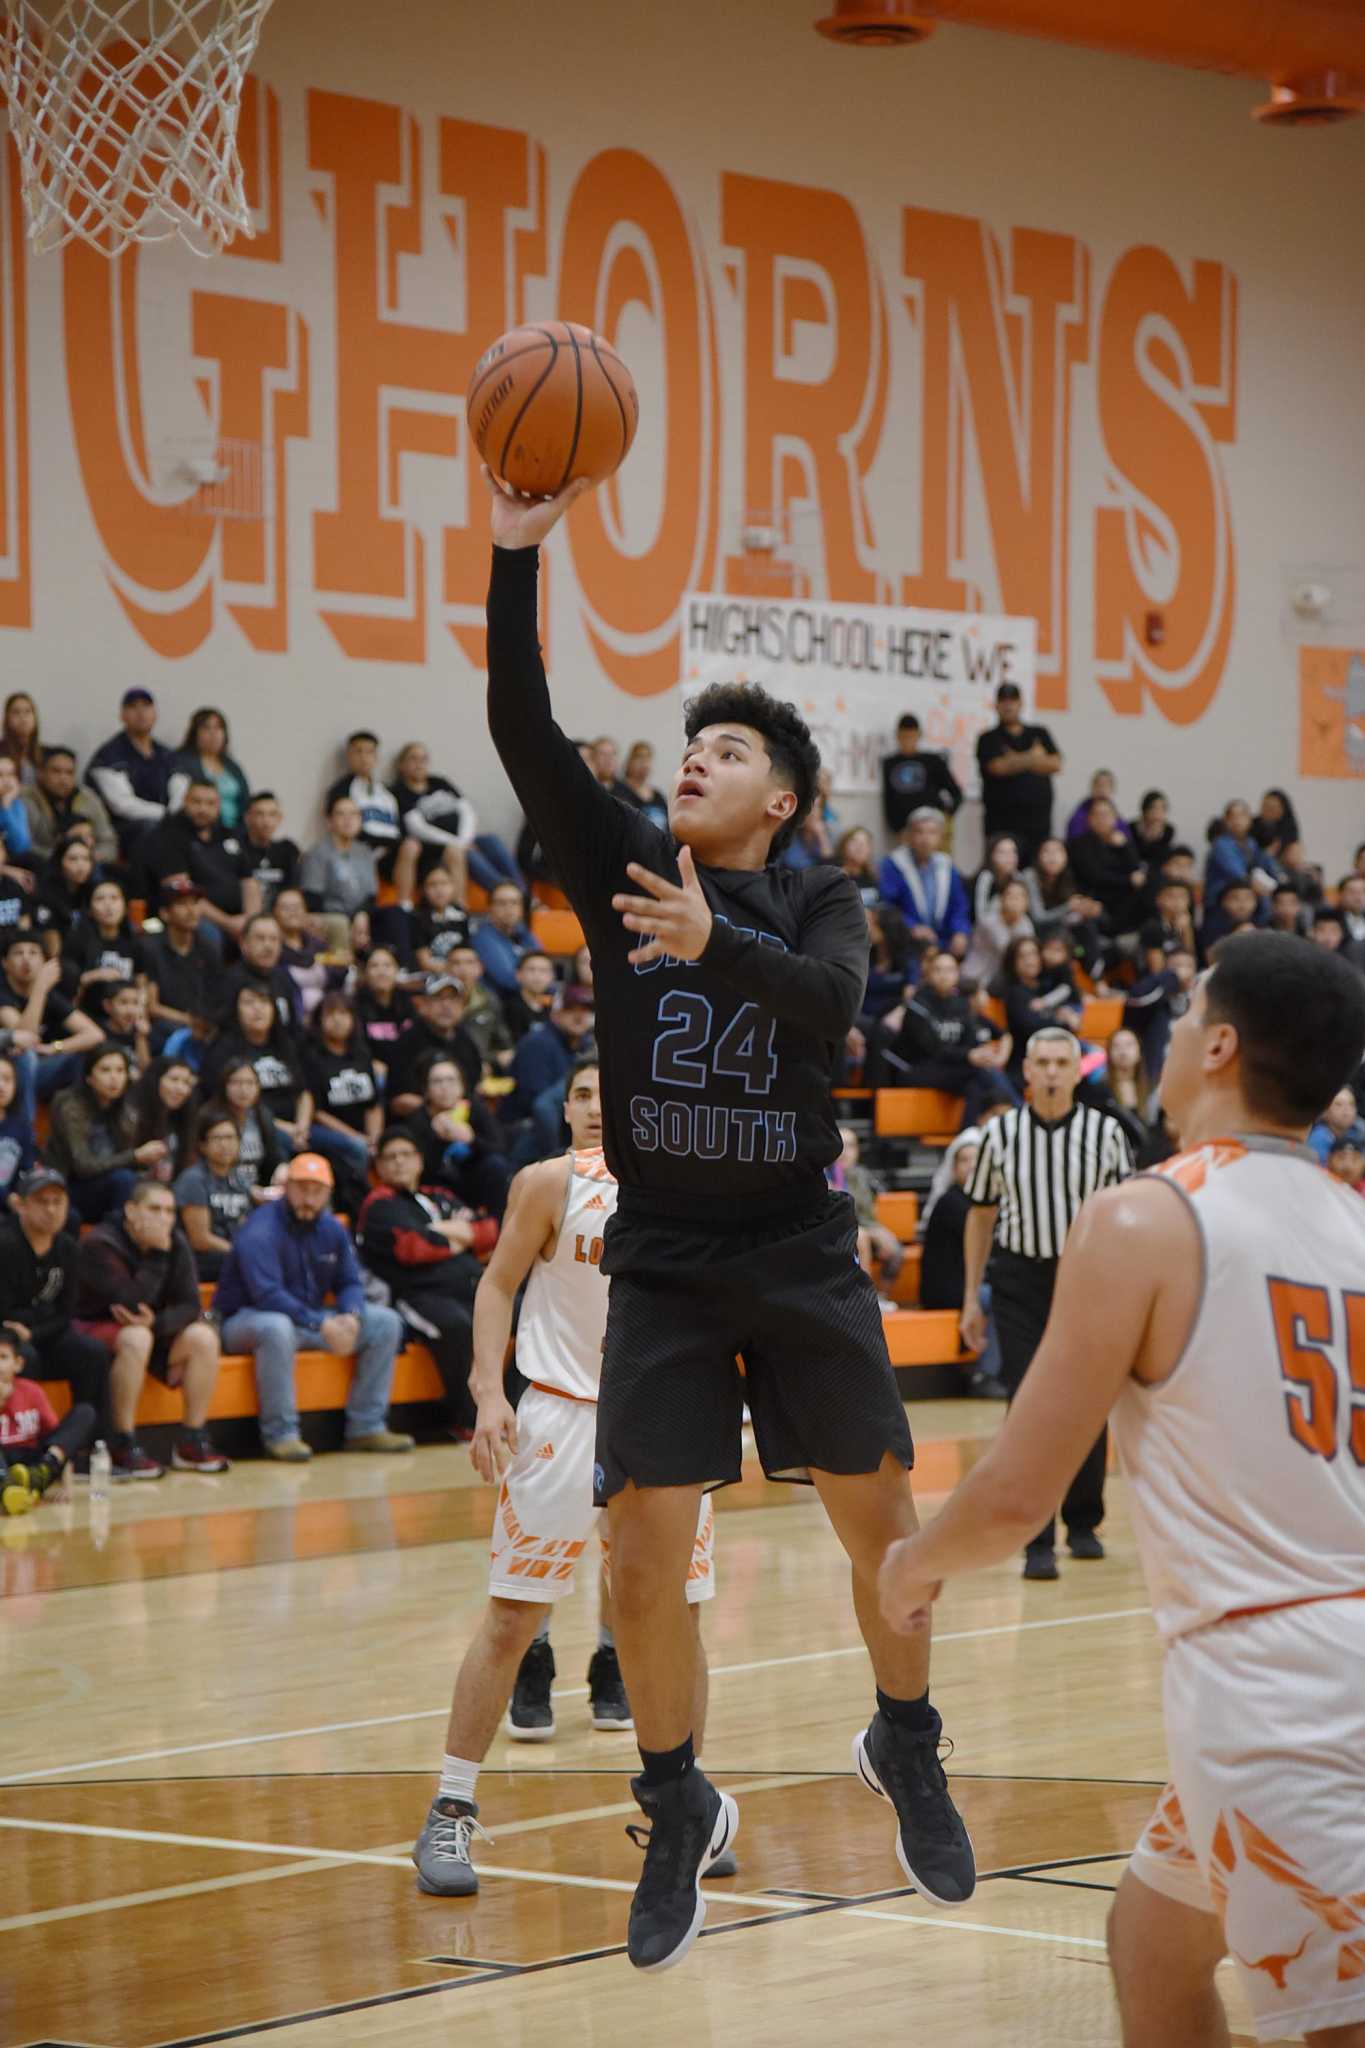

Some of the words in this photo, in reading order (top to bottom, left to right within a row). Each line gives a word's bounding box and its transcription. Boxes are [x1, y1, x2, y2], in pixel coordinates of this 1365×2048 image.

[0, 37, 1240, 725] GHORNS
[888, 627, 952, 681] HERE
[652, 990, 778, 1094] 24
[630, 1095, 797, 1162] SOUTH
[575, 1234, 604, 1265] LO
